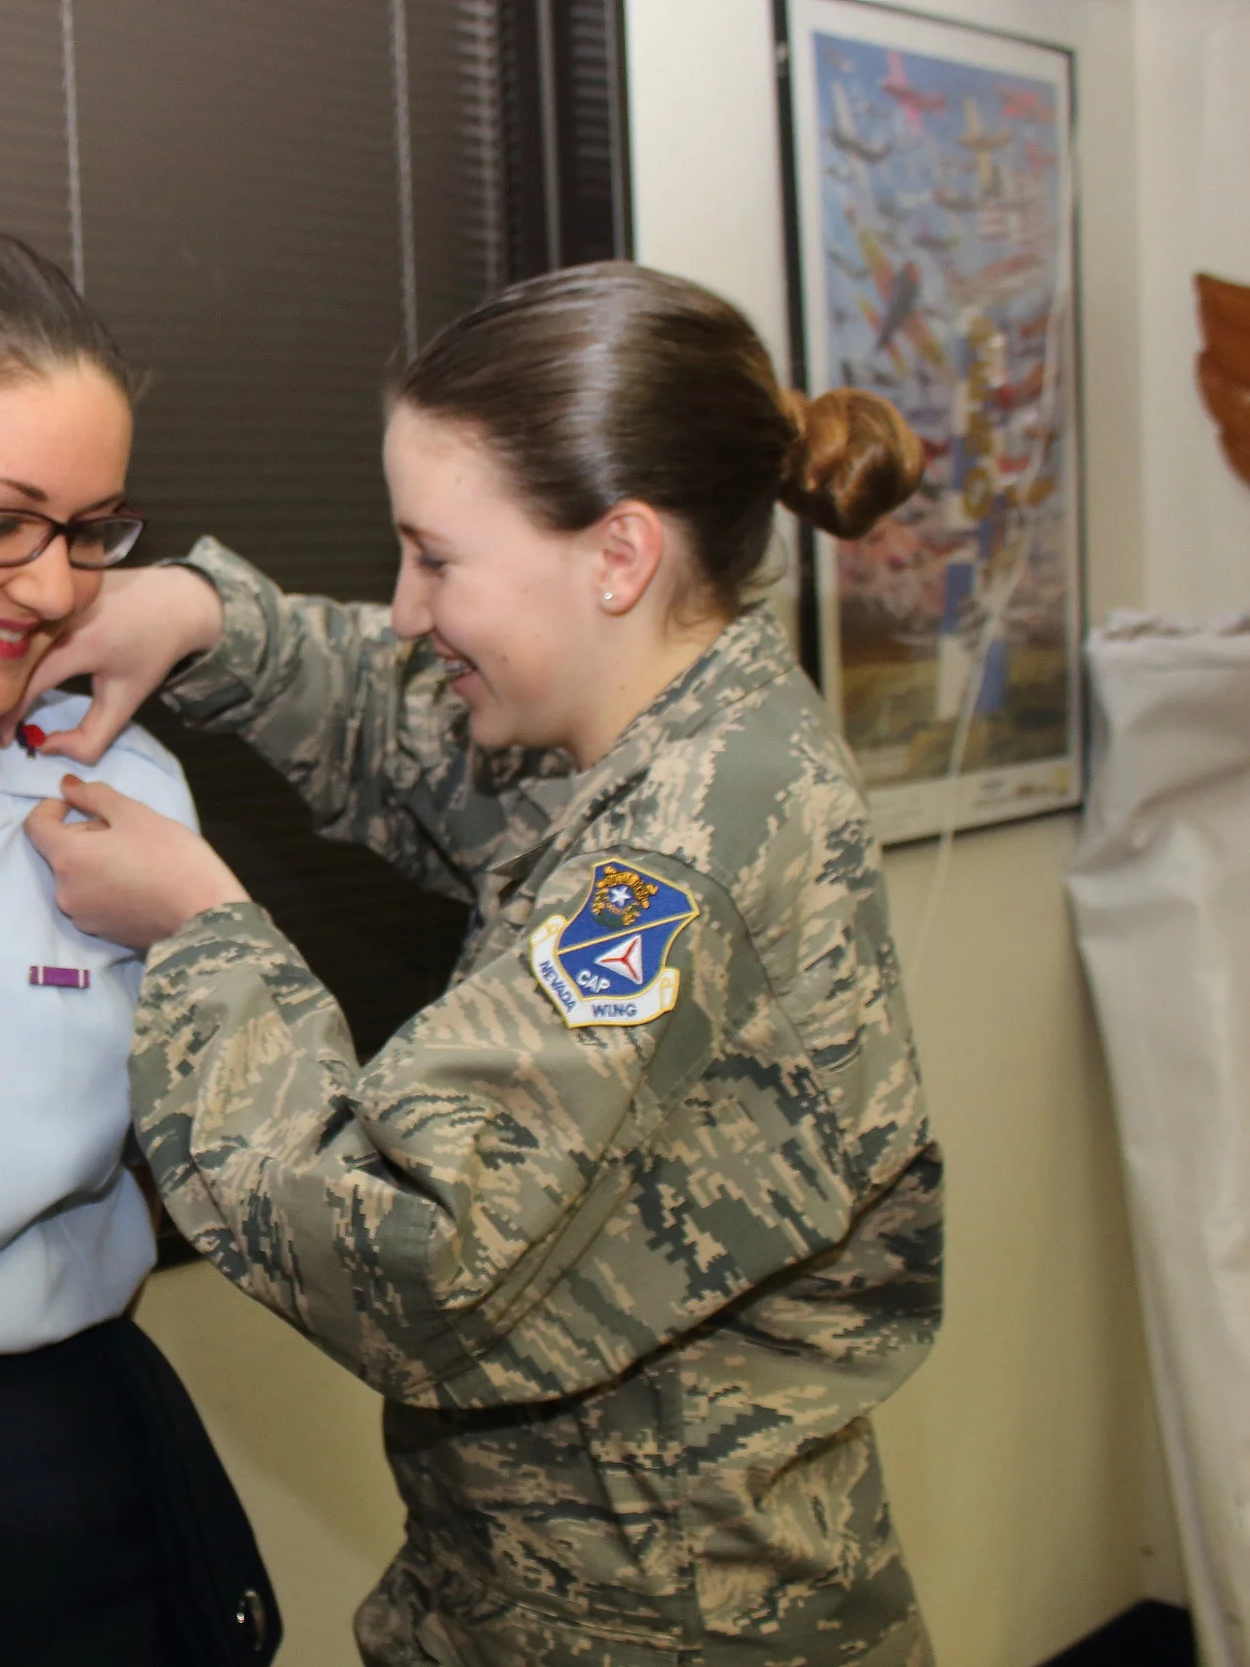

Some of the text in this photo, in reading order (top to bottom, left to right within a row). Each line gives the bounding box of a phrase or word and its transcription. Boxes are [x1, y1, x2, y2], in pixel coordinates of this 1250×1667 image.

[541, 961, 638, 1018] NEVADA WING
[577, 970, 610, 993] CAP
